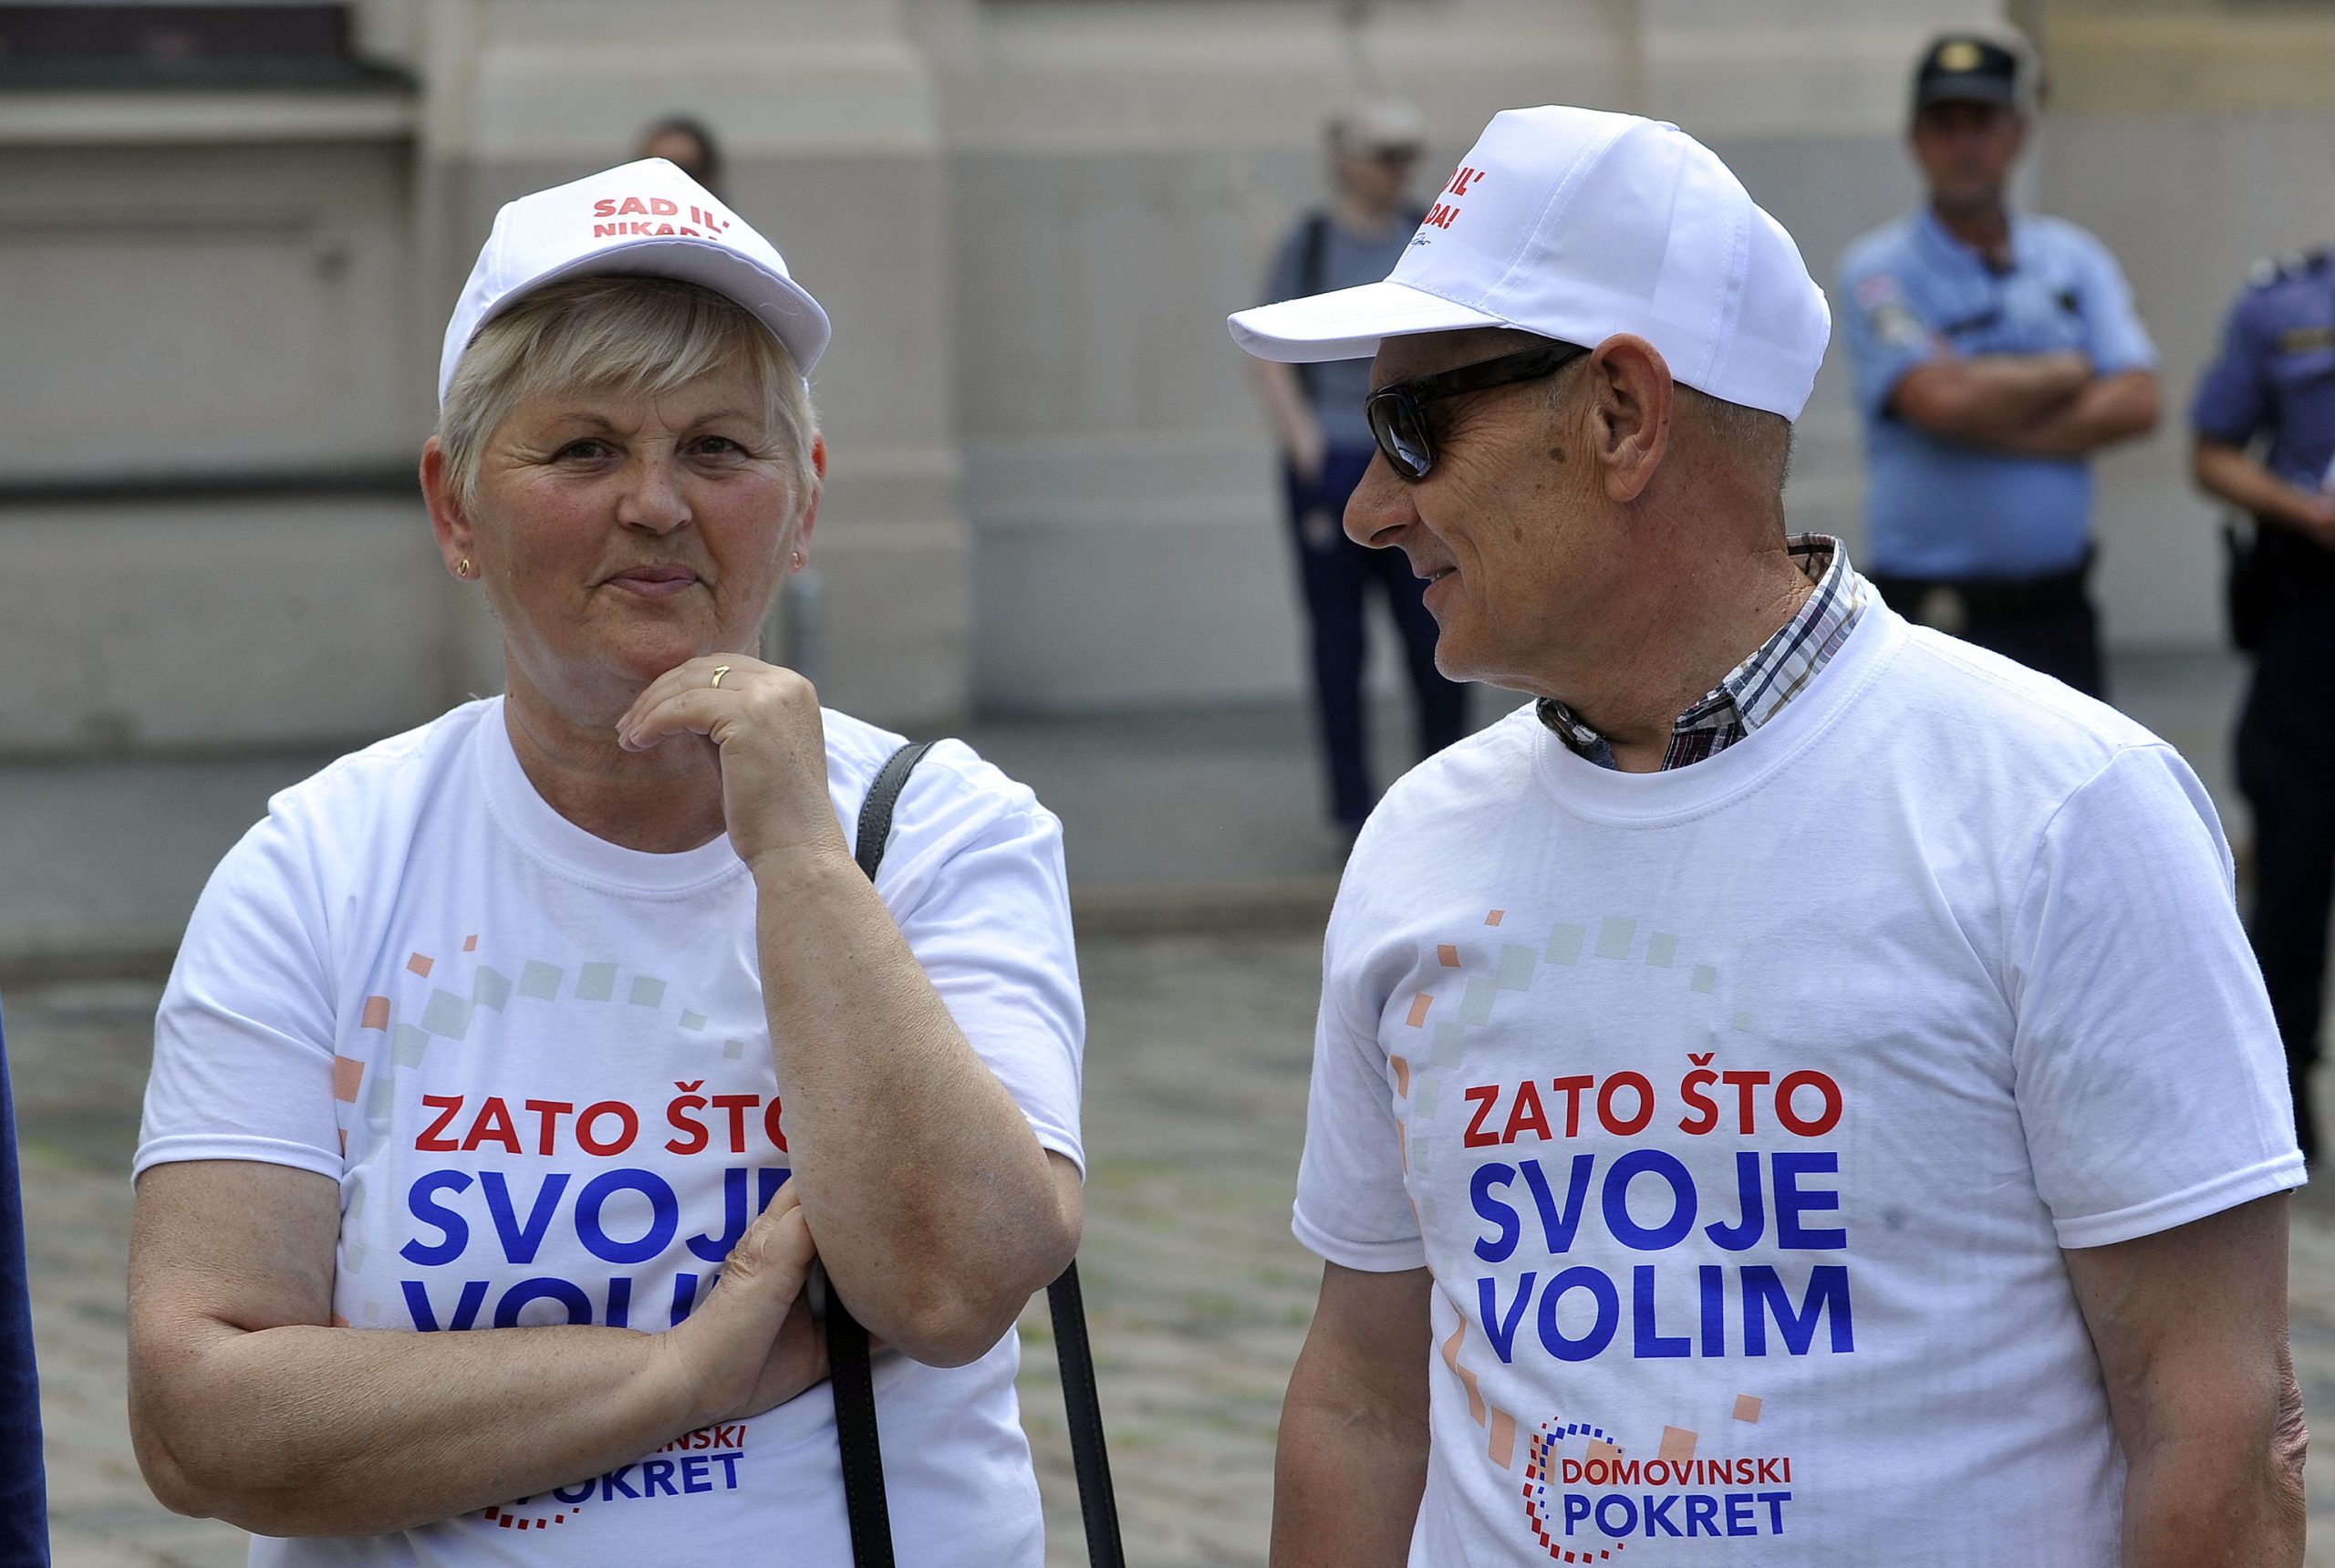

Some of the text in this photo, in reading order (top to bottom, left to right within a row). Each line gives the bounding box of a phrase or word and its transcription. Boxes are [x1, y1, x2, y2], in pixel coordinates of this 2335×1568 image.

[593, 196, 679, 217] SAD
[414, 1079, 790, 1157] ZATO ŠT
[1463, 1052, 1843, 1148] ZATO ŠTO
[1469, 1148, 1847, 1263] SVOJE
[1477, 1264, 1855, 1364] VOLIM
[516, 1451, 744, 1505] OKRET
[1562, 1457, 1791, 1486] DOMOVINSKI
[1563, 1491, 1792, 1538] POKRET
